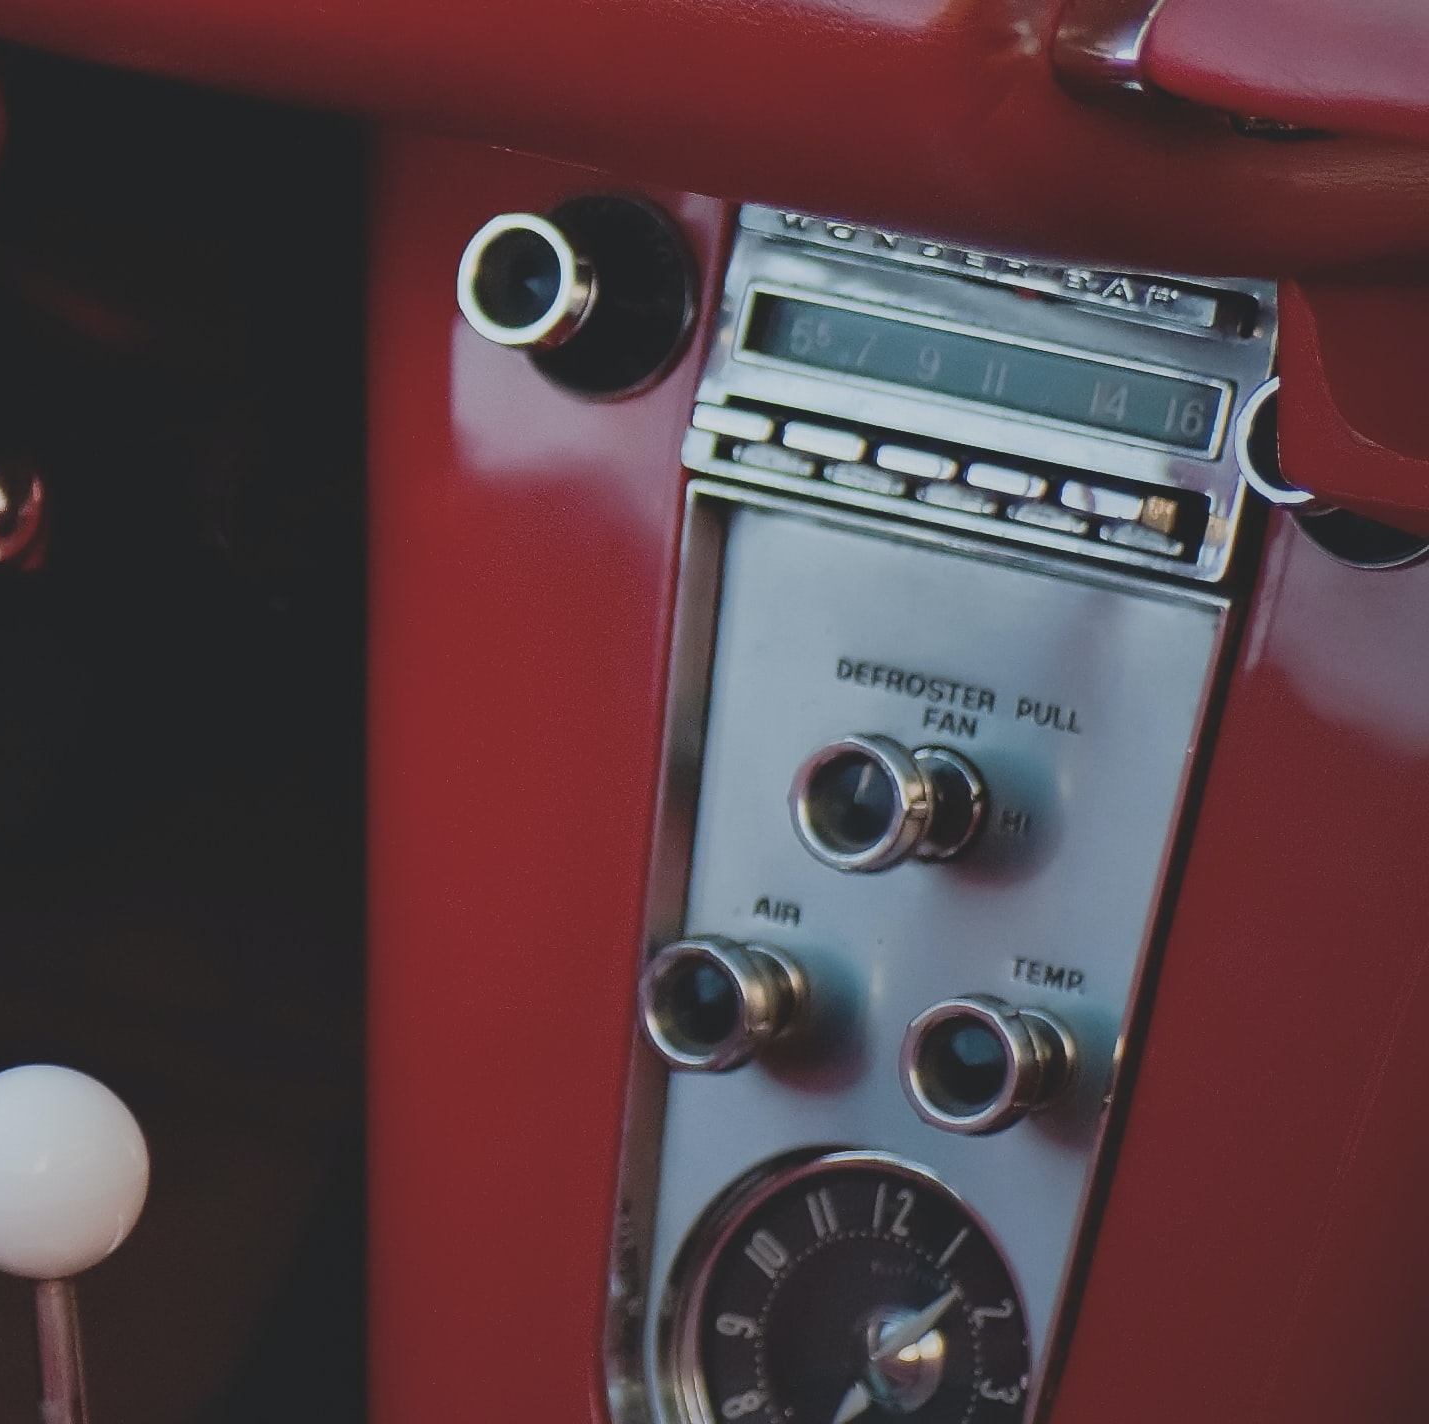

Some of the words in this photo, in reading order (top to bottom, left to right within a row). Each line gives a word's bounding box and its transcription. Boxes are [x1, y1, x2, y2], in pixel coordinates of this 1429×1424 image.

[918, 346, 941, 382] 9
[981, 360, 1009, 396] 11
[1089, 379, 1129, 422] 14
[1164, 396, 1205, 437] 16
[836, 658, 996, 714] DEFROSTER
[1015, 696, 1080, 734] PULL
[922, 707, 979, 738] FAN
[753, 895, 802, 926] AIR
[805, 1187, 838, 1238] 11
[872, 1182, 915, 1236] 12
[745, 1229, 789, 1279] 10
[935, 1227, 969, 1269] 1
[716, 1312, 759, 1339] 9
[969, 1298, 1014, 1328] 2
[722, 1391, 764, 1419] 8
[979, 1379, 1021, 1405] 3
